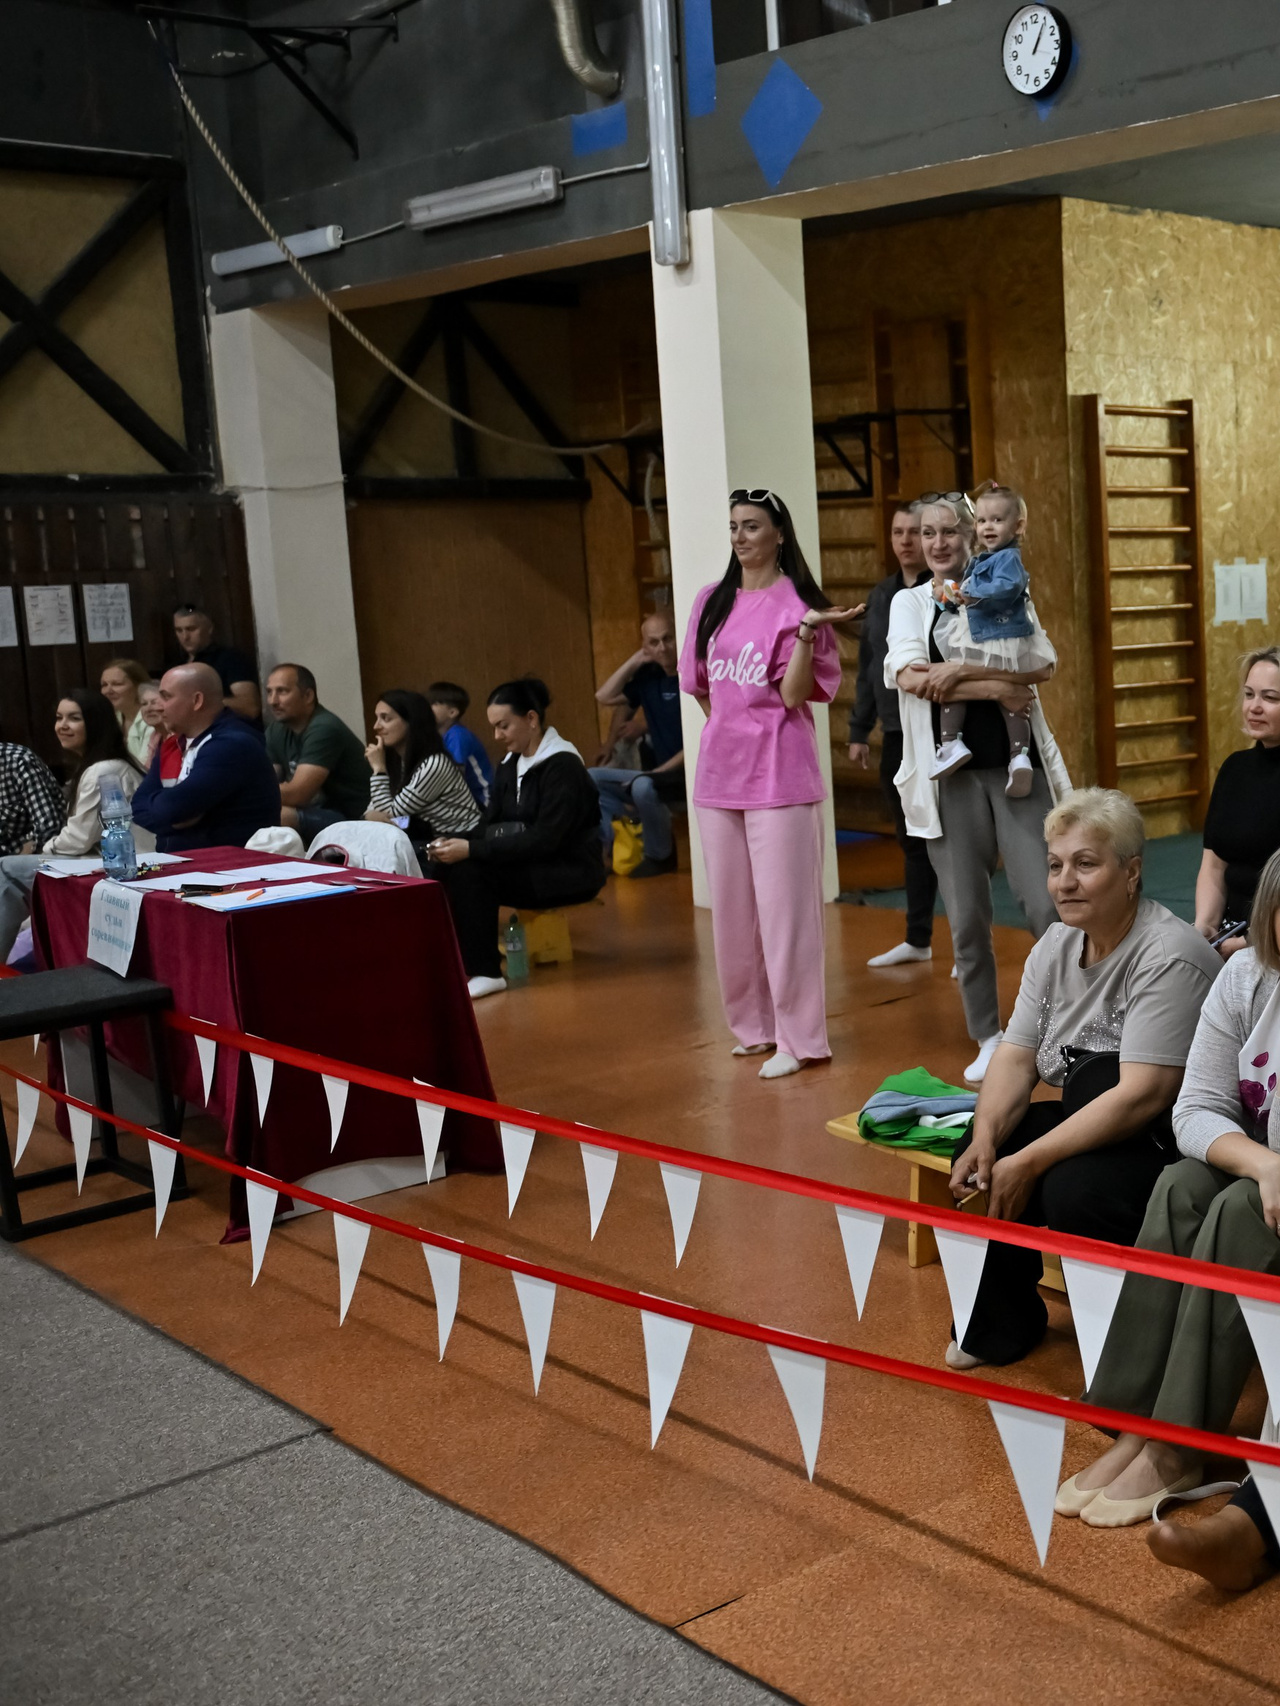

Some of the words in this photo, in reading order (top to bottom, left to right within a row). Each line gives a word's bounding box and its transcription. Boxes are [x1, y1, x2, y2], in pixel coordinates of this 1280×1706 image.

[1030, 13, 1039, 25] 12
[1021, 21, 1028, 32] 11
[1049, 25, 1056, 36] 2
[1014, 34, 1023, 45] 10
[1054, 39, 1060, 50] 3
[1012, 50, 1018, 61] 9
[1050, 56, 1058, 66] 4
[1016, 65, 1022, 76] 8
[1044, 68, 1051, 80] 5
[1024, 74, 1030, 85] 7
[1033, 76, 1040, 87] 6
